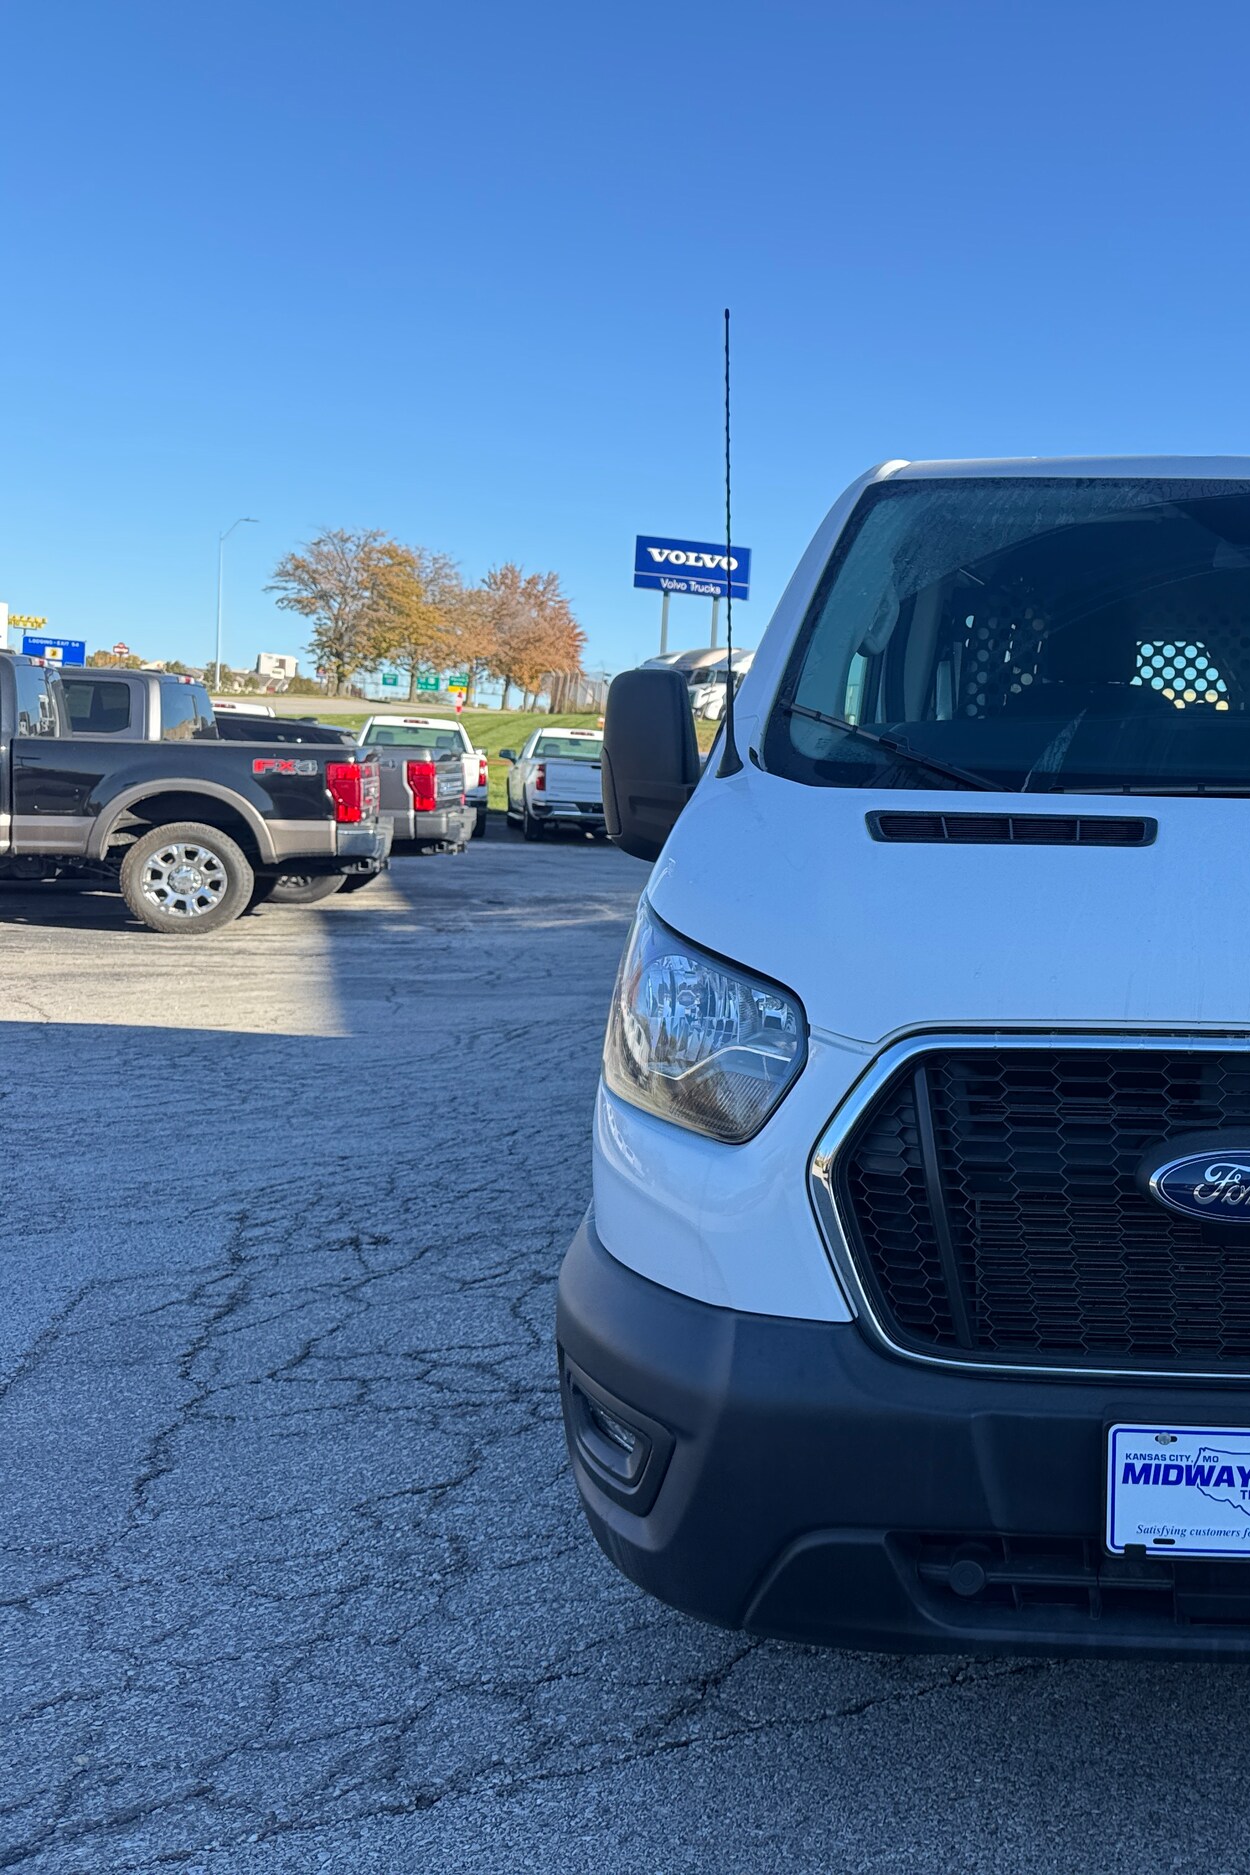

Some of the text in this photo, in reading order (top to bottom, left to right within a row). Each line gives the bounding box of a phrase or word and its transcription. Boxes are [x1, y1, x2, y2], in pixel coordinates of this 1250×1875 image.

[647, 547, 739, 571] VOLVO
[660, 578, 721, 595] Volvo Trucks
[253, 758, 318, 776] FX4
[1125, 1453, 1167, 1462] KANSAS
[1202, 1455, 1219, 1463] MO
[1136, 1524, 1187, 1538] Satisfying
[1189, 1527, 1241, 1538] customers
